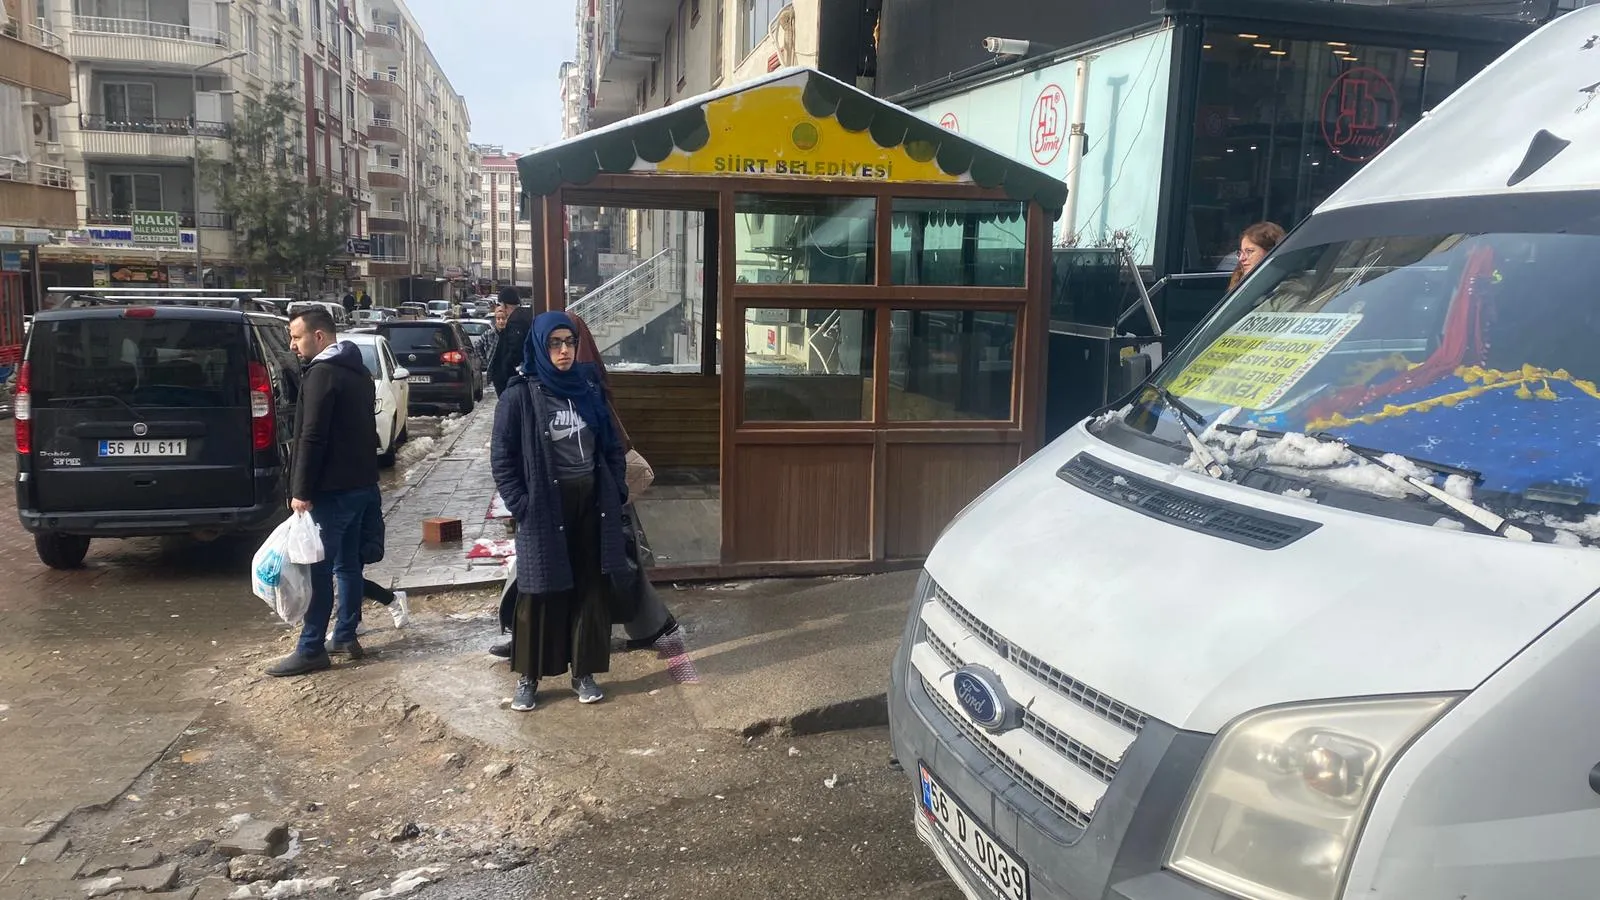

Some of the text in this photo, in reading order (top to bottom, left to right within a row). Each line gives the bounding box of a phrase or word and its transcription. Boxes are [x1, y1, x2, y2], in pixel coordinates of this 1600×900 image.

[714, 155, 893, 178] SİİRT BELEDİYESİ
[134, 214, 175, 226] HALK
[1291, 317, 1341, 336] KEZER
[1270, 356, 1298, 371] DİŞ
[108, 441, 183, 455] 56 AU 611
[958, 677, 984, 714] Ford
[931, 781, 949, 823] 56
[956, 808, 967, 842] D
[974, 830, 1024, 900] 0039
